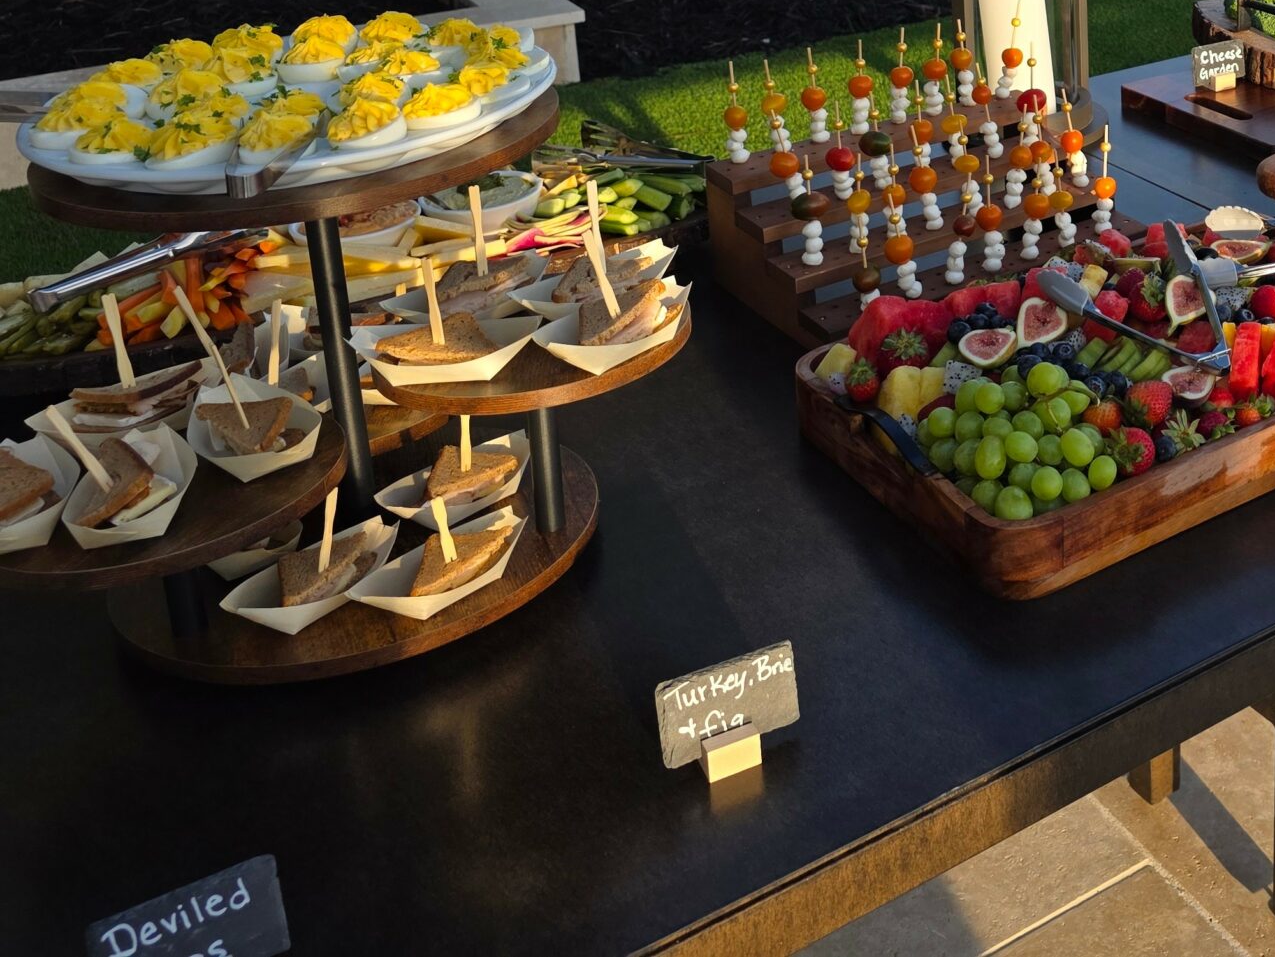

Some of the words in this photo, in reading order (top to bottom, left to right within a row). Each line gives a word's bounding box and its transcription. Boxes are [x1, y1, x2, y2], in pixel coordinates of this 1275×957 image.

[1200, 48, 1243, 64] Cheese
[751, 654, 794, 682] Brie
[100, 877, 251, 957] Deviled
